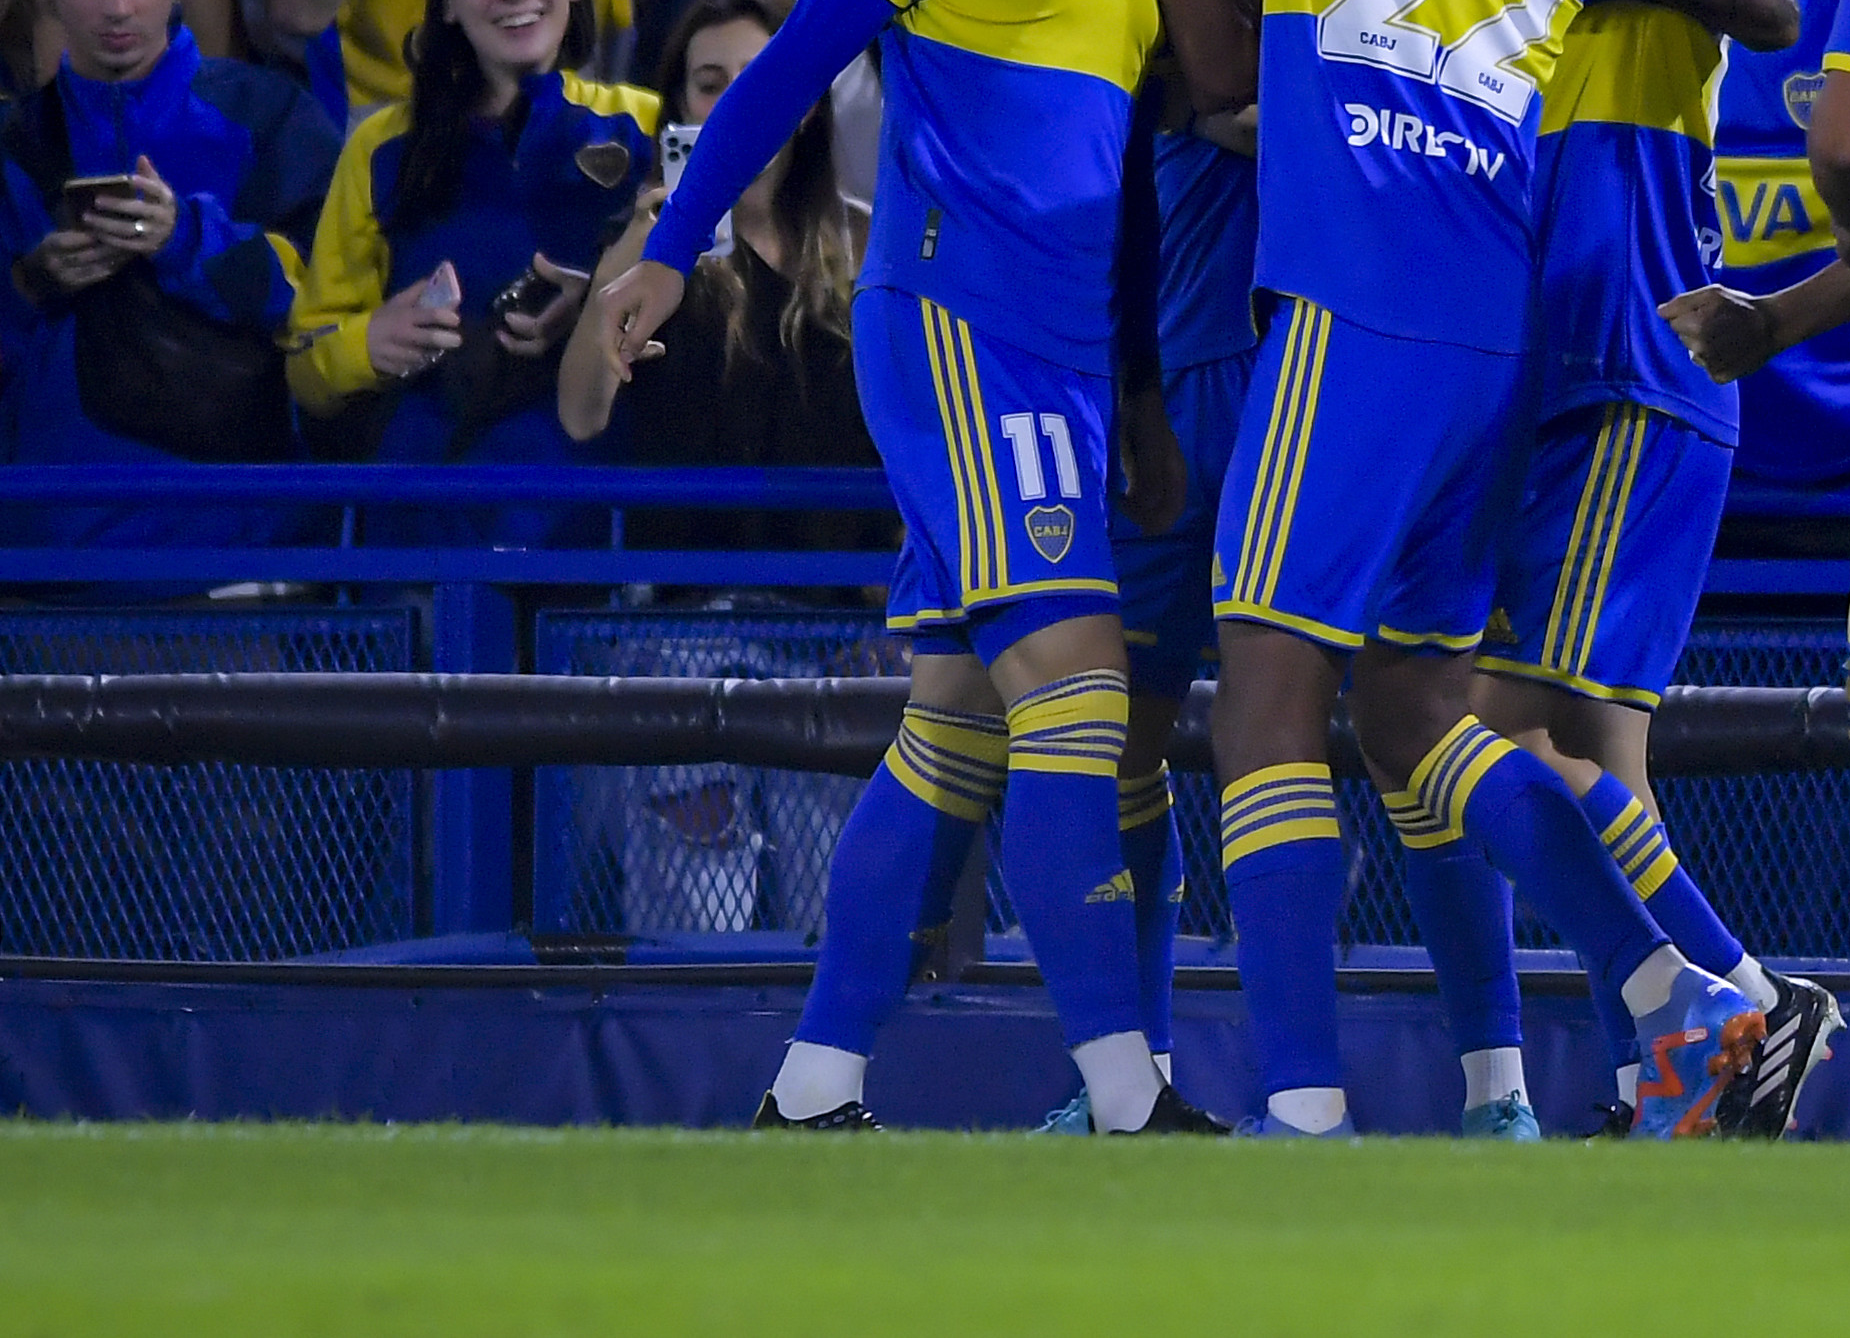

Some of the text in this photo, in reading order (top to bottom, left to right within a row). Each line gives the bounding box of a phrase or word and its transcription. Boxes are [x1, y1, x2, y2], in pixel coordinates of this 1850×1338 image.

[1360, 31, 1398, 52] CABJ
[1478, 72, 1505, 94] CABJ
[1718, 180, 1813, 238] VA
[1000, 412, 1082, 501] 11
[1034, 525, 1068, 538] CABJ
